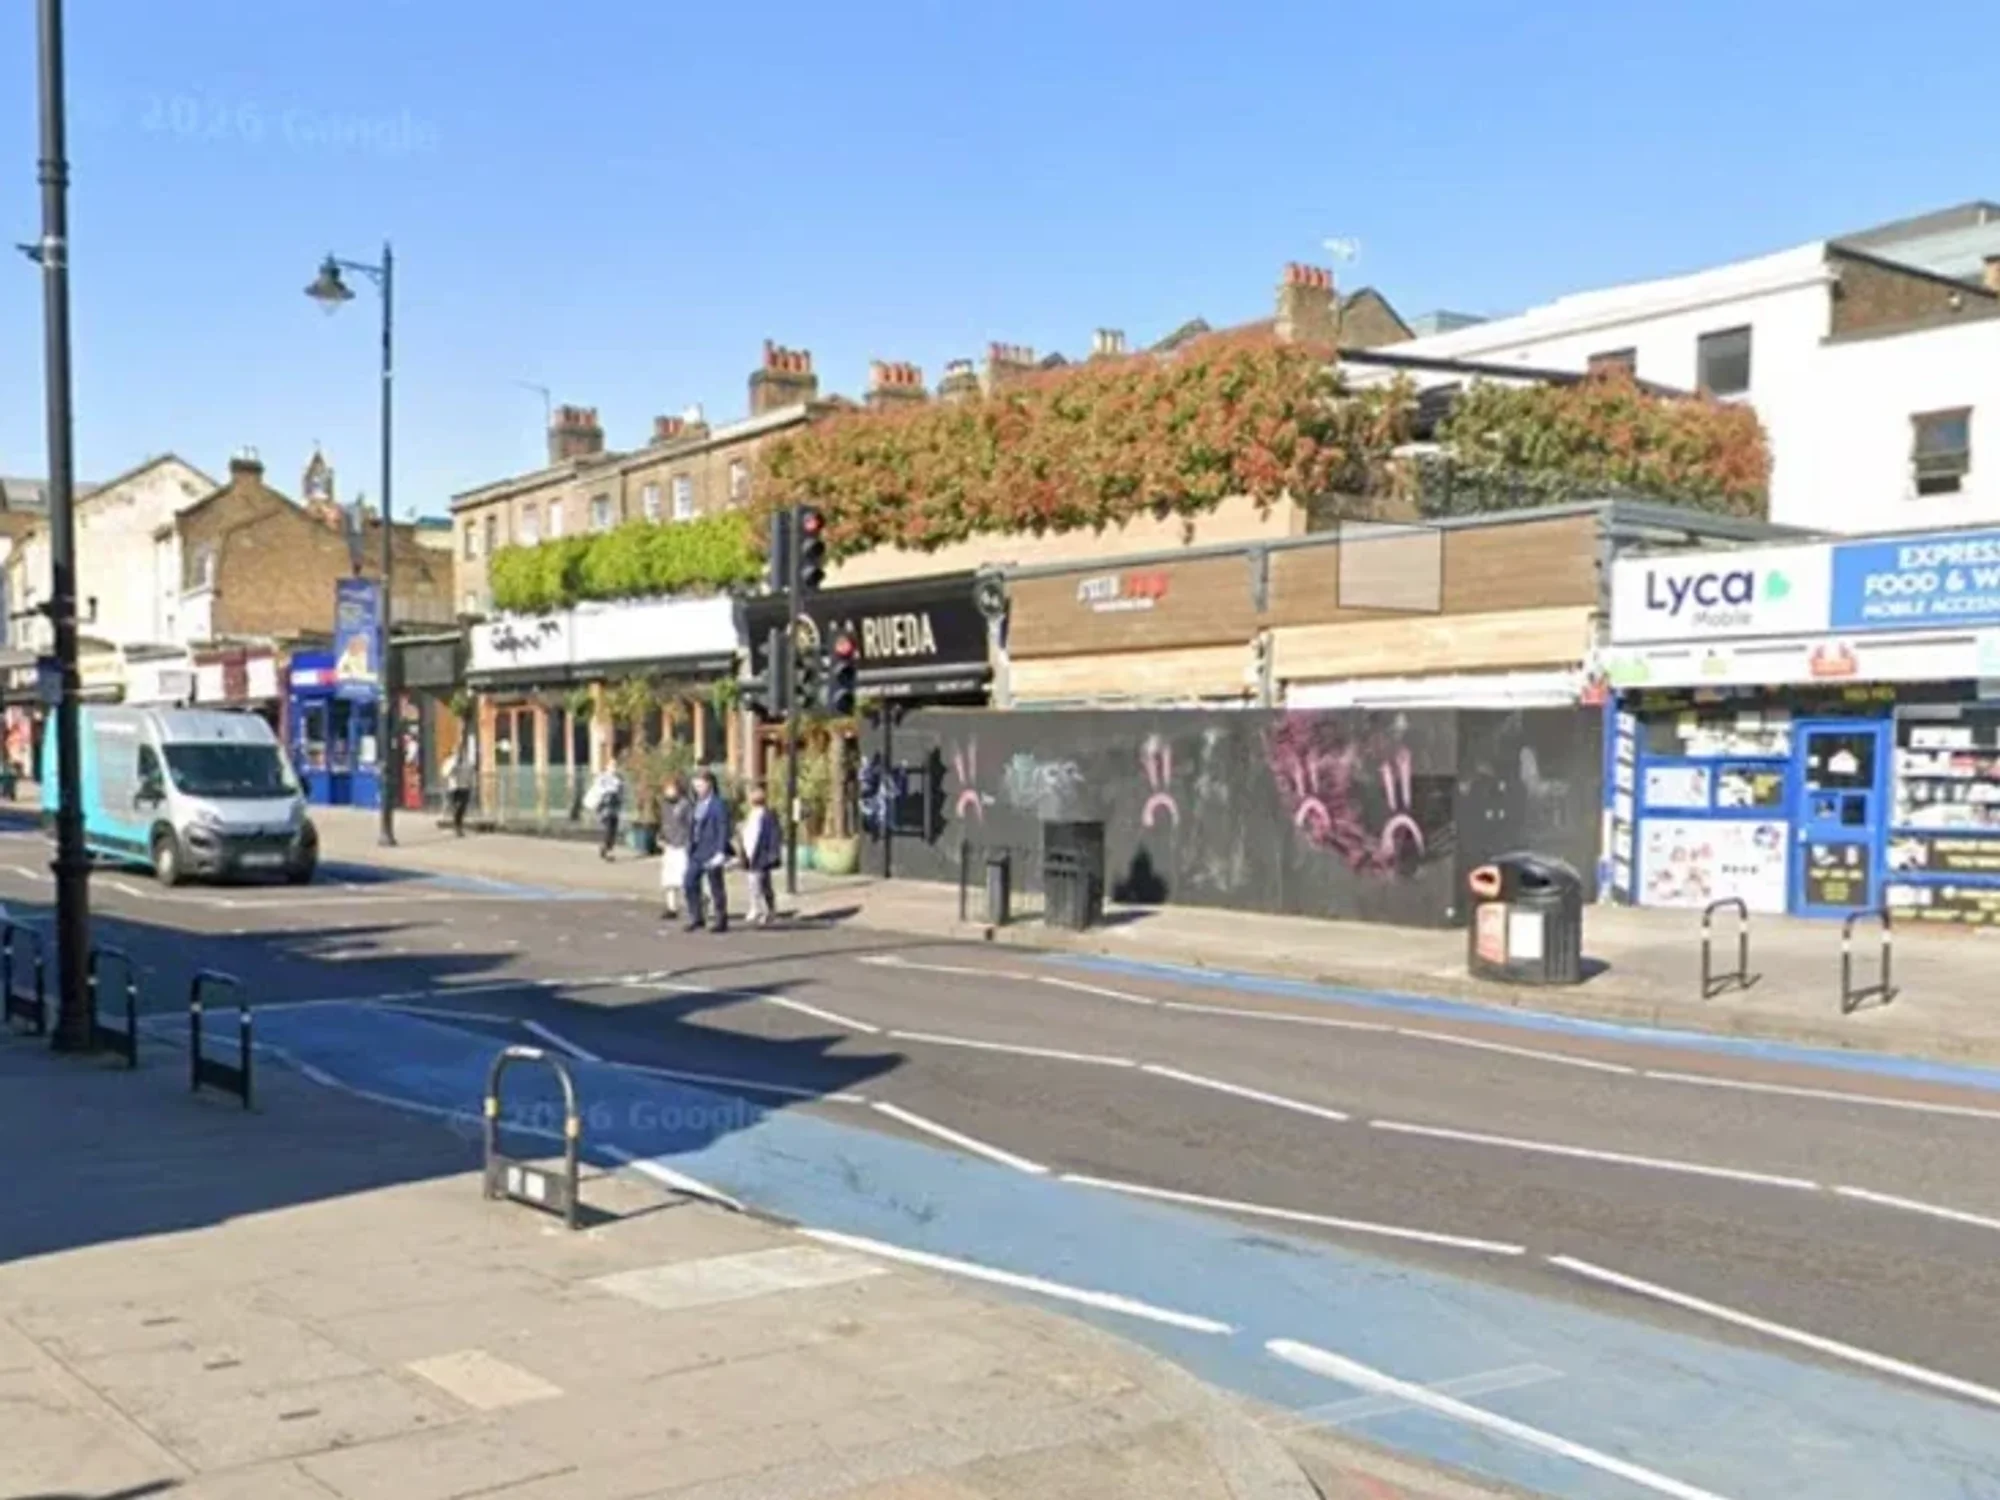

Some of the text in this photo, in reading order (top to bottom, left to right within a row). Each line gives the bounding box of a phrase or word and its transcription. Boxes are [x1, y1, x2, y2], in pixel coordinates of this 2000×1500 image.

[1646, 570, 1755, 616] Lyca
[1865, 573, 1939, 597] FOOD
[1945, 568, 1965, 592] &
[862, 612, 937, 659] RUEDA
[1691, 611, 1753, 628] Mobile
